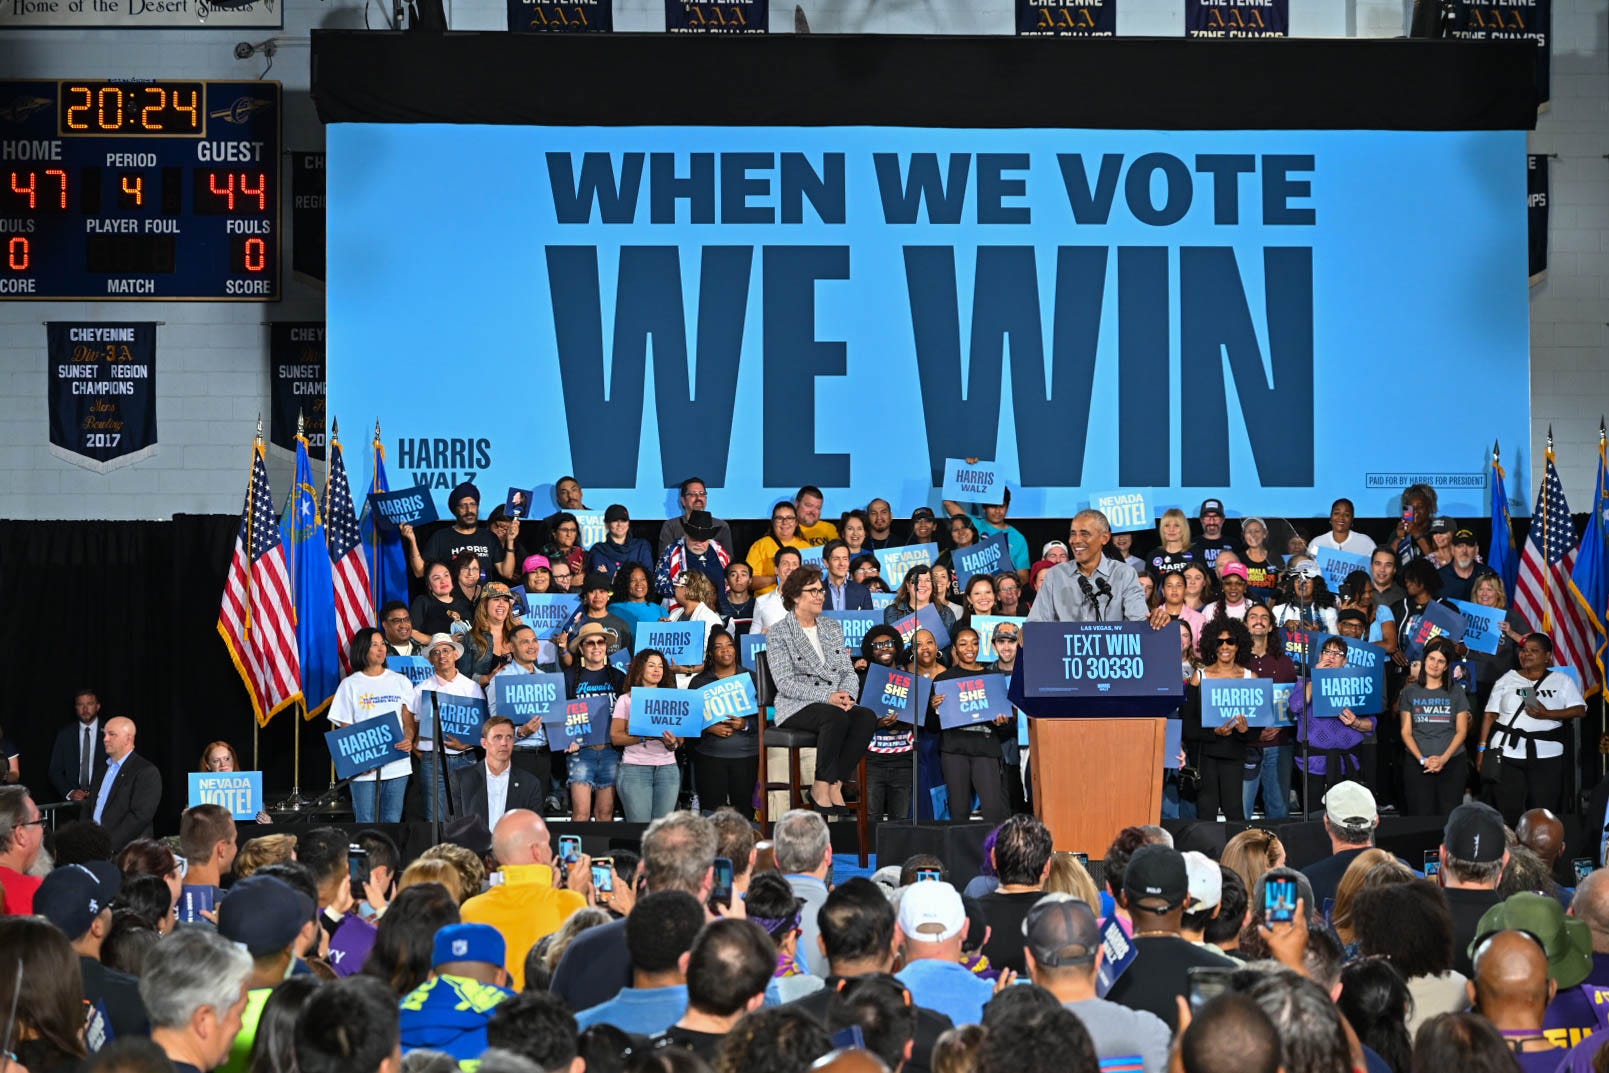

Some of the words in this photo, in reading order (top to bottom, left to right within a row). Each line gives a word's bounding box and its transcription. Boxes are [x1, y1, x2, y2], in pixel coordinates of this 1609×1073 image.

[67, 87, 197, 129] 20:24
[2, 140, 62, 161] HOME
[197, 141, 264, 162] GUEST
[106, 153, 157, 168] PERIOD
[11, 169, 66, 209] 47
[122, 177, 141, 205] 4
[210, 173, 265, 210] 44
[544, 152, 846, 225] WHEN
[873, 152, 1031, 225] WE
[1056, 152, 1316, 226] VOTE
[0, 219, 35, 234] OULS
[86, 218, 138, 234] PLAYER
[144, 218, 181, 234] FOUL
[226, 220, 271, 235] FOULS
[0, 279, 36, 294] CORE
[107, 279, 155, 294] MATCH
[225, 279, 271, 294] SCORE
[70, 328, 135, 342] CHEYENNE
[290, 328, 325, 341] CHEY
[58, 365, 98, 378] SUNSET
[111, 365, 148, 378] REGION
[279, 365, 320, 378] SUNSET
[544, 245, 851, 489] WE
[902, 245, 1315, 488] WIN
[72, 381, 134, 395] CHAMPIONS
[86, 433, 121, 447] 2017
[398, 438, 491, 469] HARRIS
[956, 469, 995, 486] HARRIS
[1369, 476, 1384, 485] PAID
[1385, 476, 1398, 485] FOR
[1399, 476, 1408, 485] BY
[1409, 476, 1434, 485] HARRIS
[1435, 476, 1448, 485] FOR
[1449, 476, 1483, 486] PRESIDENT
[961, 484, 988, 494] WALZ
[377, 495, 424, 516] HARRIS
[1099, 494, 1144, 507] NEVADA
[389, 511, 421, 524] WALZ
[1100, 503, 1147, 527] VOTE!
[884, 549, 930, 562] NEVADA
[962, 543, 1001, 572] HARRIS
[527, 605, 568, 619] HARRIS
[533, 620, 562, 629] WALZ
[649, 632, 692, 647] HARRIS
[1064, 634, 1101, 656] TEXT
[1106, 634, 1141, 655] WIN
[1062, 658, 1083, 679] TO
[1086, 657, 1144, 679] 30330
[889, 672, 912, 688] YES
[957, 679, 985, 692] YES
[1321, 676, 1373, 696] HARRIS
[505, 683, 556, 703] HARRIS
[704, 681, 743, 699] EVADA
[884, 683, 909, 698] SHE
[959, 689, 986, 702] SHE
[1211, 688, 1264, 706] HARRIS
[514, 703, 550, 715] WALZ
[644, 699, 689, 716] HARRIS
[881, 694, 907, 709] CAN
[960, 699, 989, 712] CAN
[1330, 696, 1366, 708] WALZ
[1220, 707, 1256, 717] WALZ
[1423, 706, 1450, 714] WALZ
[565, 713, 589, 726] SHE
[651, 716, 682, 725] WALZ
[565, 723, 592, 736] CAN
[338, 724, 393, 757] HARRIS
[351, 744, 389, 764] WALZ
[199, 778, 251, 789] NEVADA
[200, 789, 252, 814] VOTE!
